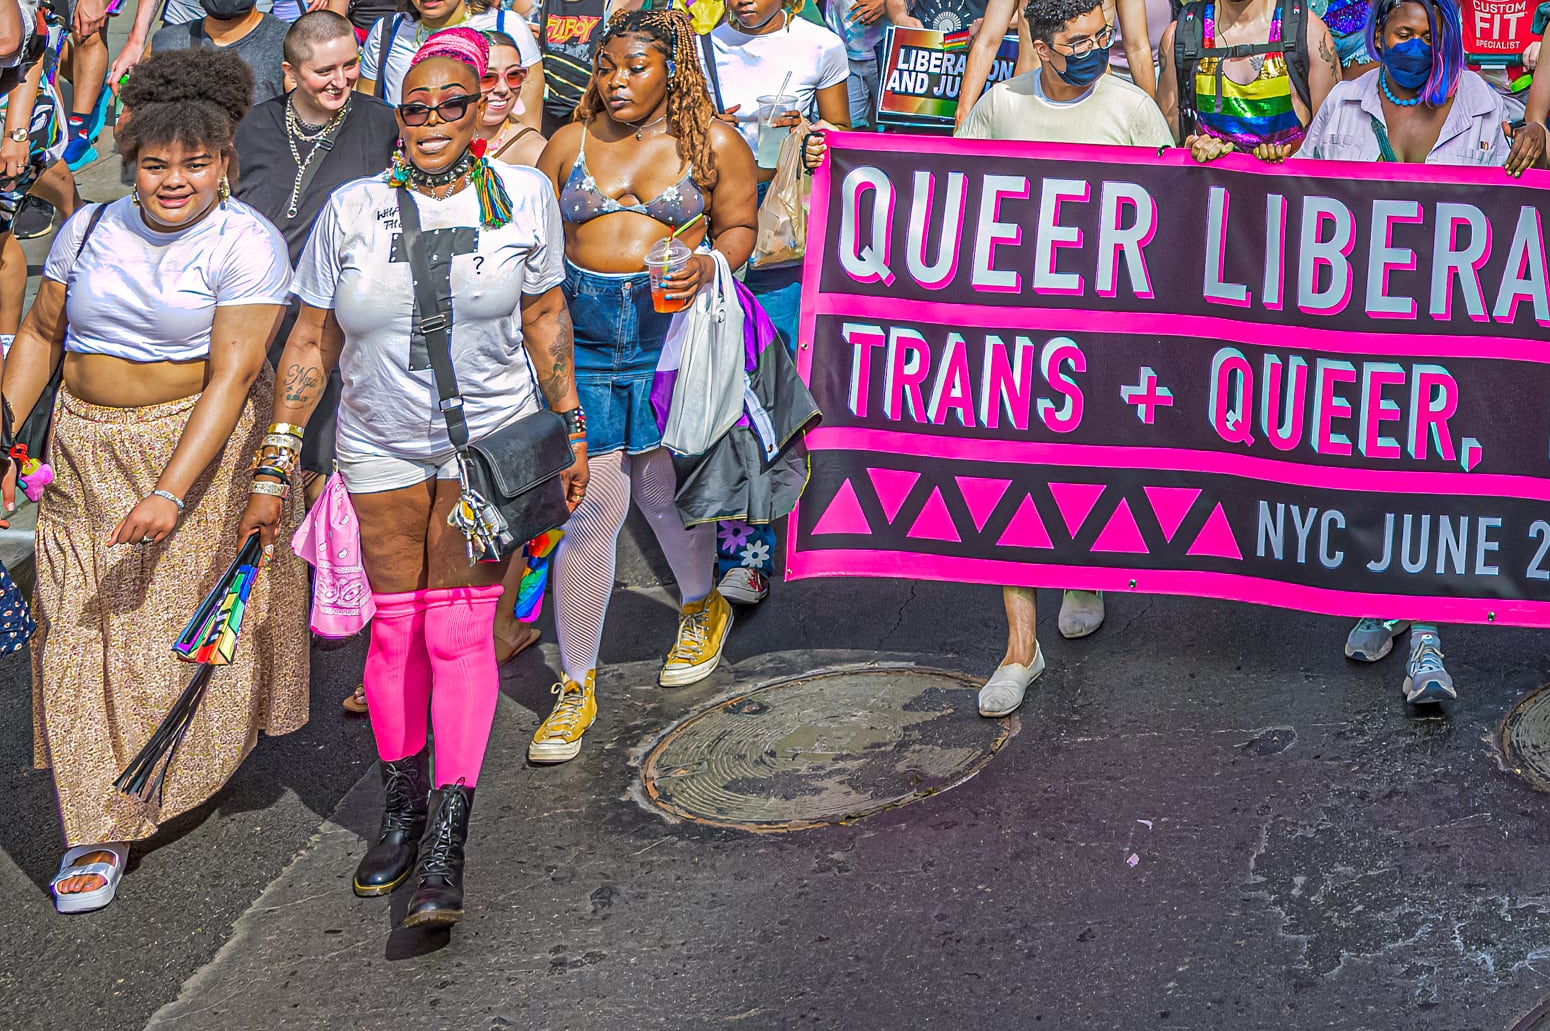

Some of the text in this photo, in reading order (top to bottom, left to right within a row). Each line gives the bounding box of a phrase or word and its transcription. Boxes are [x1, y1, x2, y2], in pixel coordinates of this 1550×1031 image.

[1473, 0, 1526, 13] CUSTOM
[1474, 11, 1525, 39] FIT
[1476, 39, 1521, 49] SPECIALIST
[886, 70, 929, 94] AND
[839, 165, 1159, 301] QUEER
[842, 321, 1087, 436] TRANS
[1119, 366, 1174, 425] +
[1208, 346, 1484, 472] QUEER,
[1256, 500, 1347, 568] NYC
[1365, 511, 1503, 576] JUNE
